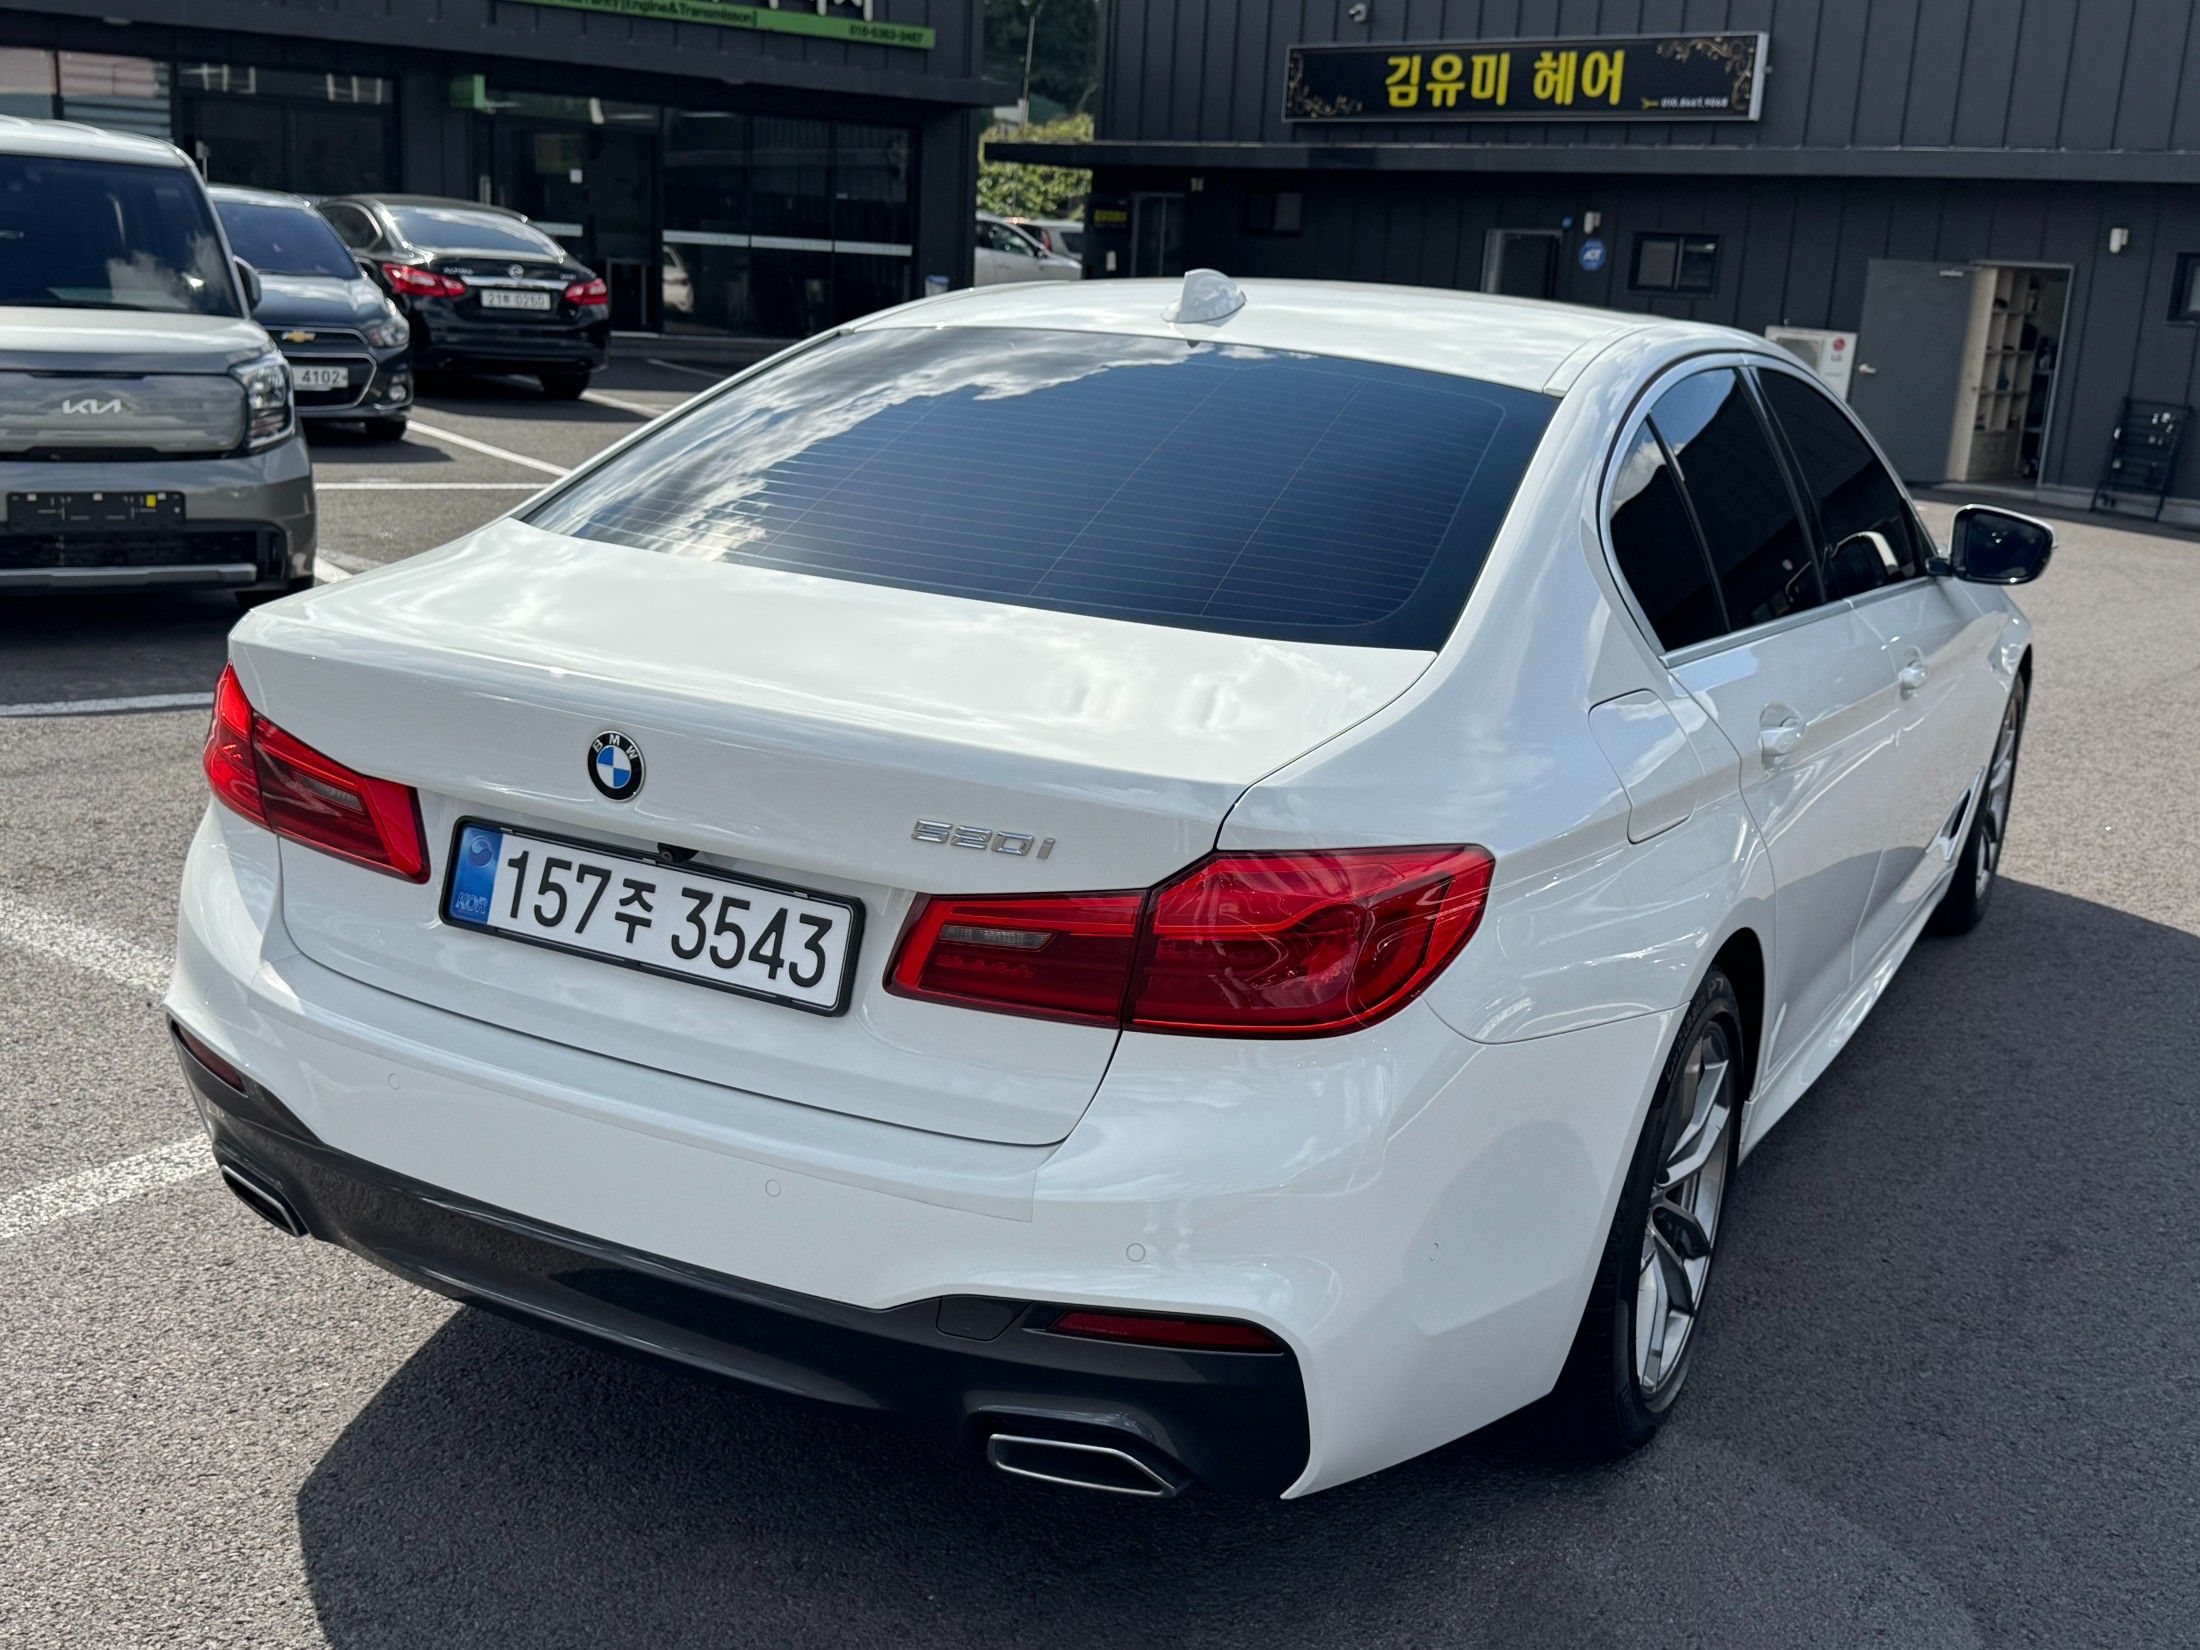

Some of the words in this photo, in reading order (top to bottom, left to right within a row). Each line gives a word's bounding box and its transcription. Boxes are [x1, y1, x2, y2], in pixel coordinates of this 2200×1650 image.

[1385, 52, 1511, 108] 김유미
[1533, 49, 1625, 106] 헤어
[302, 369, 341, 385] 4102
[62, 398, 122, 415] KIA
[591, 733, 639, 760] BMW
[910, 817, 1056, 861] 520i
[454, 891, 489, 915] KOR
[507, 849, 657, 944] 157주
[670, 886, 834, 989] 3543
